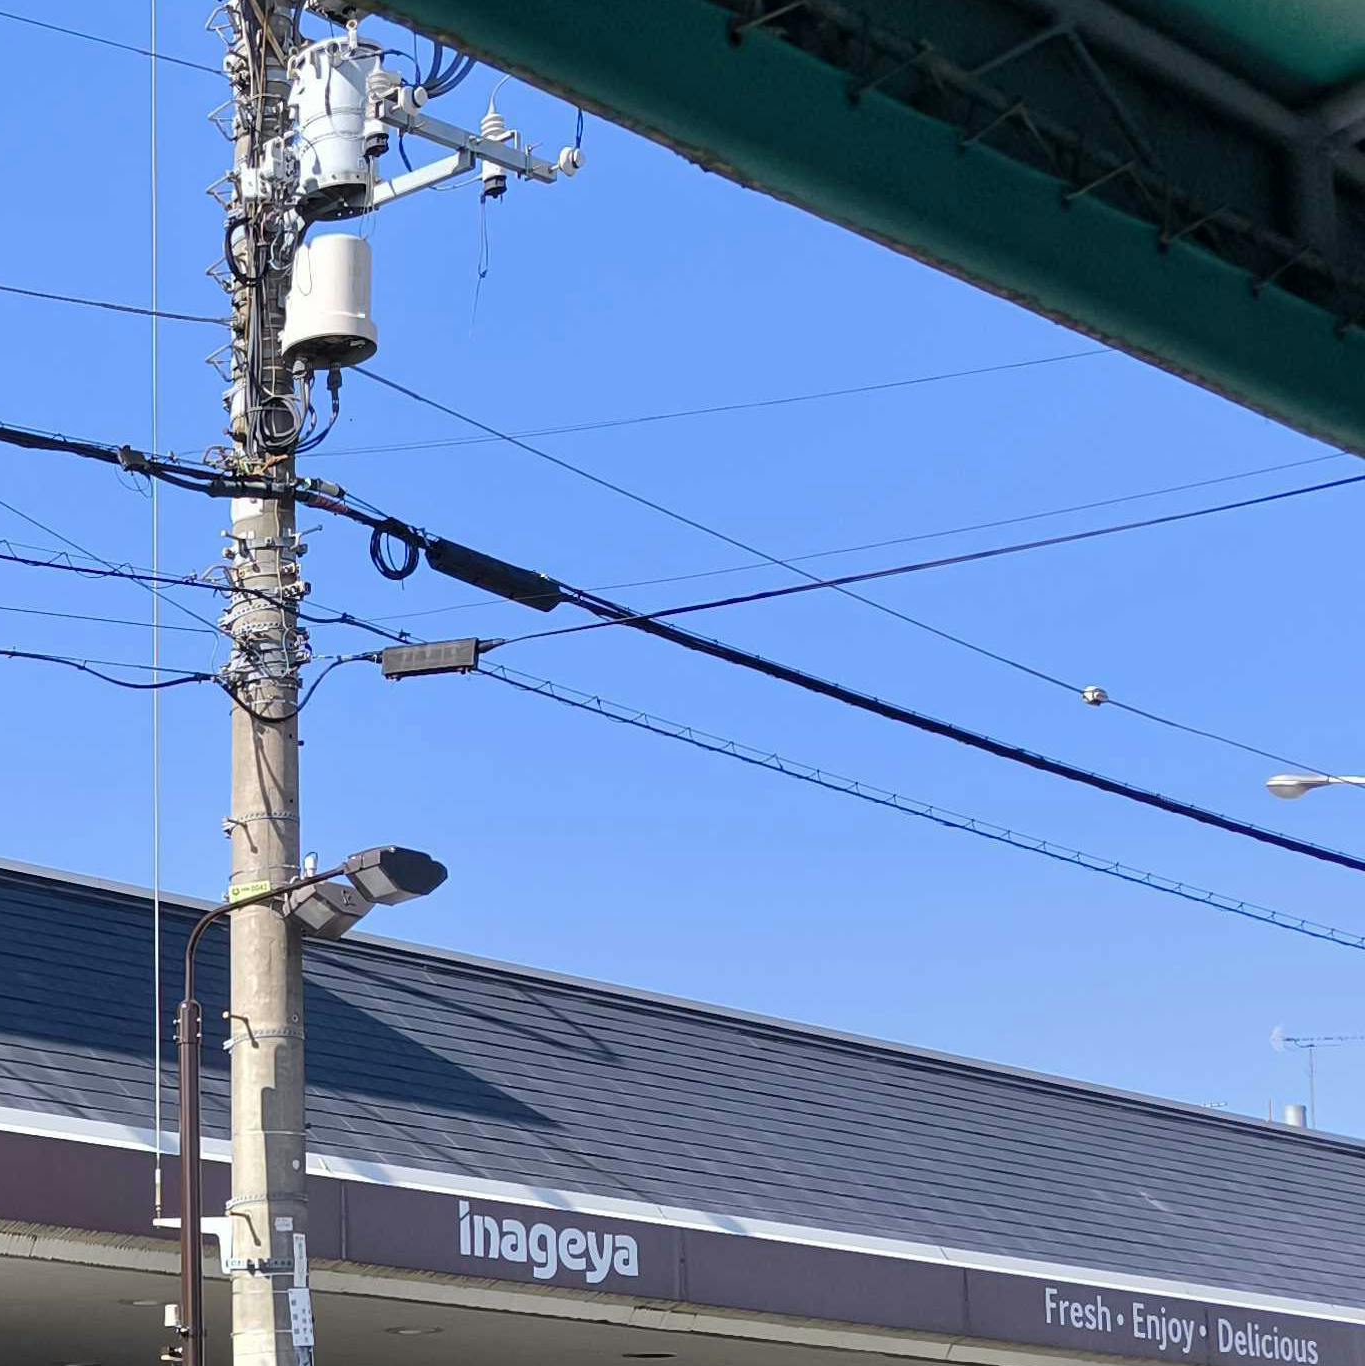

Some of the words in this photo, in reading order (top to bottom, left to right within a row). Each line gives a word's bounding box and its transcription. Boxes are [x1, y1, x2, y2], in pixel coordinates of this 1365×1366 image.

[1044, 1287, 1112, 1335] Fresh
[1132, 1302, 1195, 1356] Enjoy
[1216, 1317, 1319, 1366] Delicious
